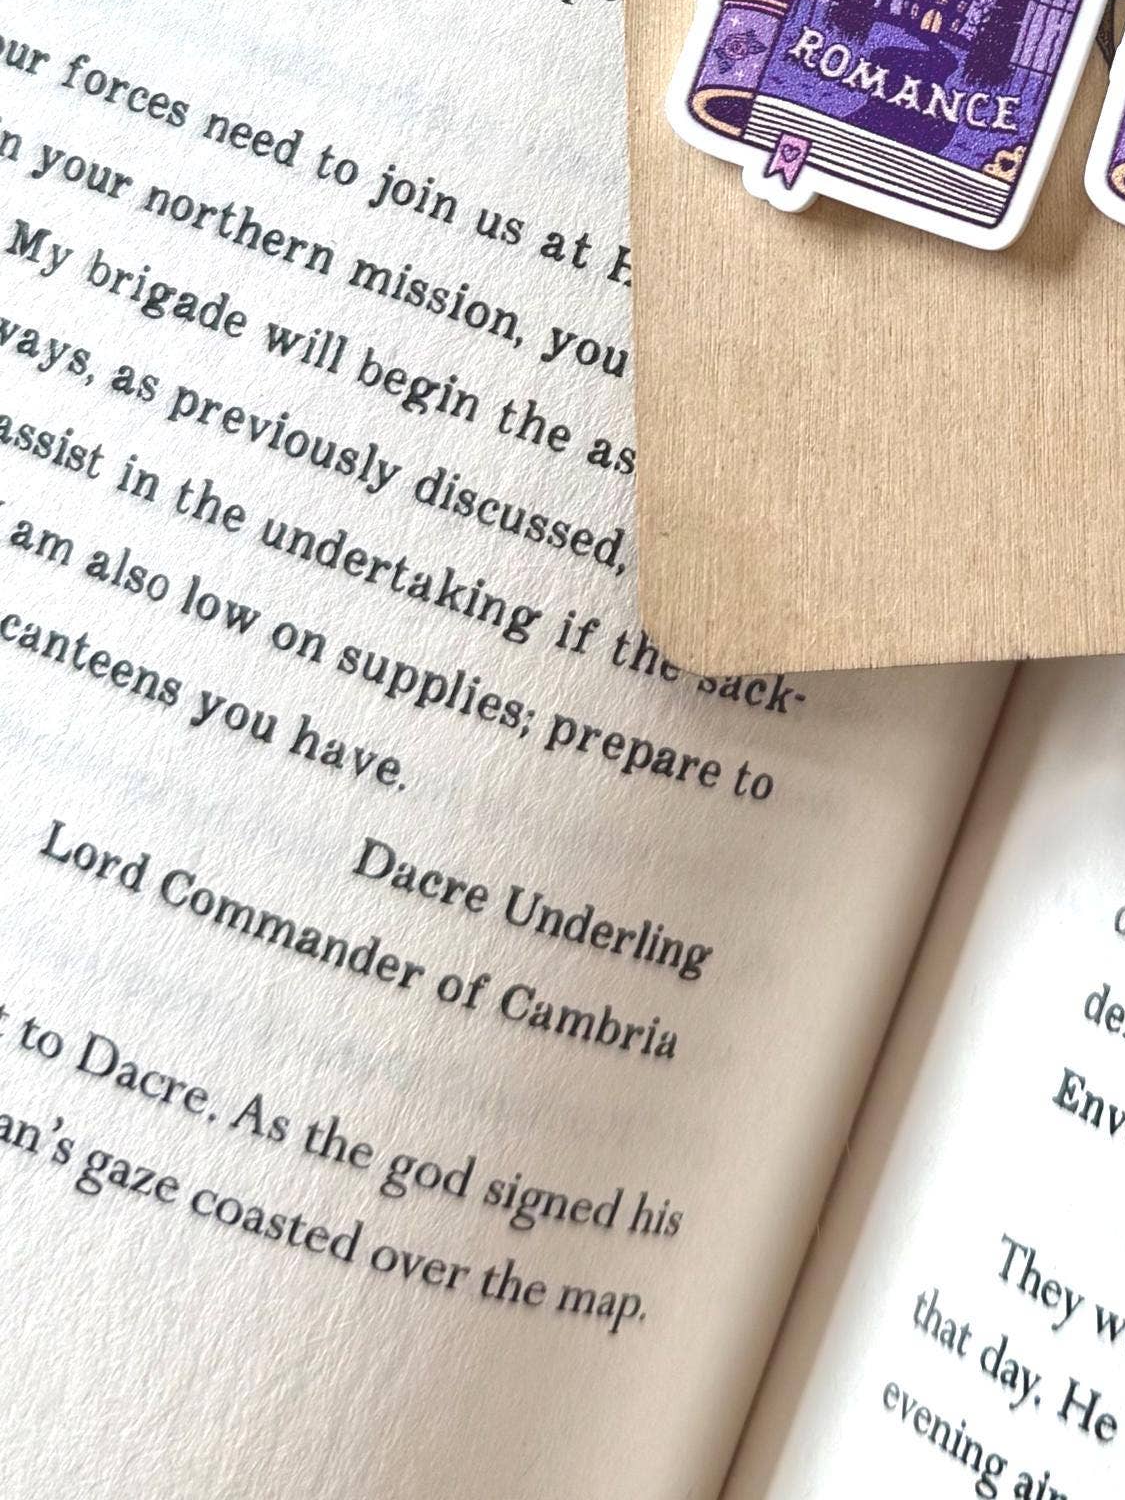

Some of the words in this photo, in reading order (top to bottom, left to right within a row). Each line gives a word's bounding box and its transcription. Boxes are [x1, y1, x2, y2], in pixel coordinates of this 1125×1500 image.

[60, 54, 190, 128] forces
[202, 113, 304, 167] need
[316, 145, 359, 186] to
[368, 164, 457, 224] join
[475, 208, 525, 245] us
[539, 232, 592, 270] at
[787, 27, 1021, 132] ROMANCE
[4, 219, 74, 278] My
[86, 248, 247, 338] brigade
[267, 322, 348, 374] will
[356, 347, 479, 422] begin
[498, 399, 571, 453] the
[0, 614, 182, 710] canteens
[189, 690, 277, 744] you
[288, 714, 405, 791] have.
[9, 520, 73, 566] am
[84, 547, 169, 602] also
[180, 575, 261, 635] low
[268, 622, 326, 664] on
[336, 646, 535, 739] supplies;
[544, 714, 721, 789] prepare
[733, 761, 774, 801] to
[39, 819, 151, 894] Lord
[159, 869, 425, 990] Commander
[437, 973, 491, 1011] of
[498, 984, 677, 1062] Cambria
[352, 837, 489, 914] Dacre
[504, 885, 713, 983] Underling
[19, 1017, 63, 1060] to
[75, 1031, 216, 1123] Dacre.
[229, 1093, 289, 1143] As
[303, 1116, 373, 1170] the
[379, 1155, 476, 1200] god
[483, 1173, 624, 1233] signed
[628, 1192, 682, 1237] his
[74, 1150, 179, 1205] gaze
[190, 1190, 363, 1265] coasted
[370, 1246, 470, 1291] over
[480, 1259, 547, 1309] the
[555, 1286, 645, 1336] map.
[999, 1234, 1084, 1332] They
